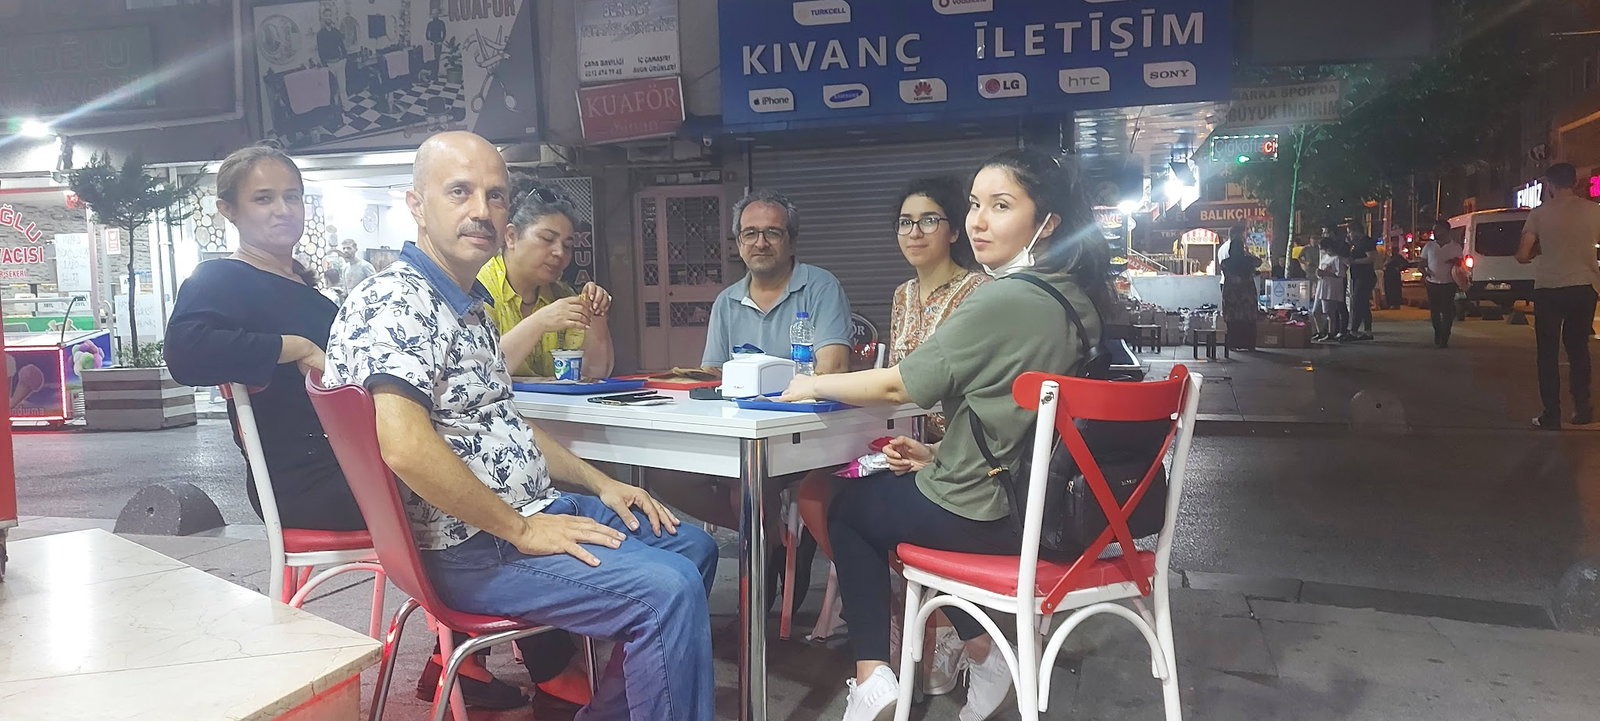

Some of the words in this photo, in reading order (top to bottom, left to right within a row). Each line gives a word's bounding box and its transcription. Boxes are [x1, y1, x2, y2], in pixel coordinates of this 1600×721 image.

[810, 7, 846, 17] TURKCELL
[742, 33, 921, 75] KIVANÇ
[974, 9, 1204, 60] İLETİŞİM
[1150, 69, 1190, 80] SONY
[1003, 79, 1020, 90] LG
[586, 84, 678, 118] KUAFÖR
[762, 96, 789, 105] iPhone
[0, 246, 44, 264] ACISI
